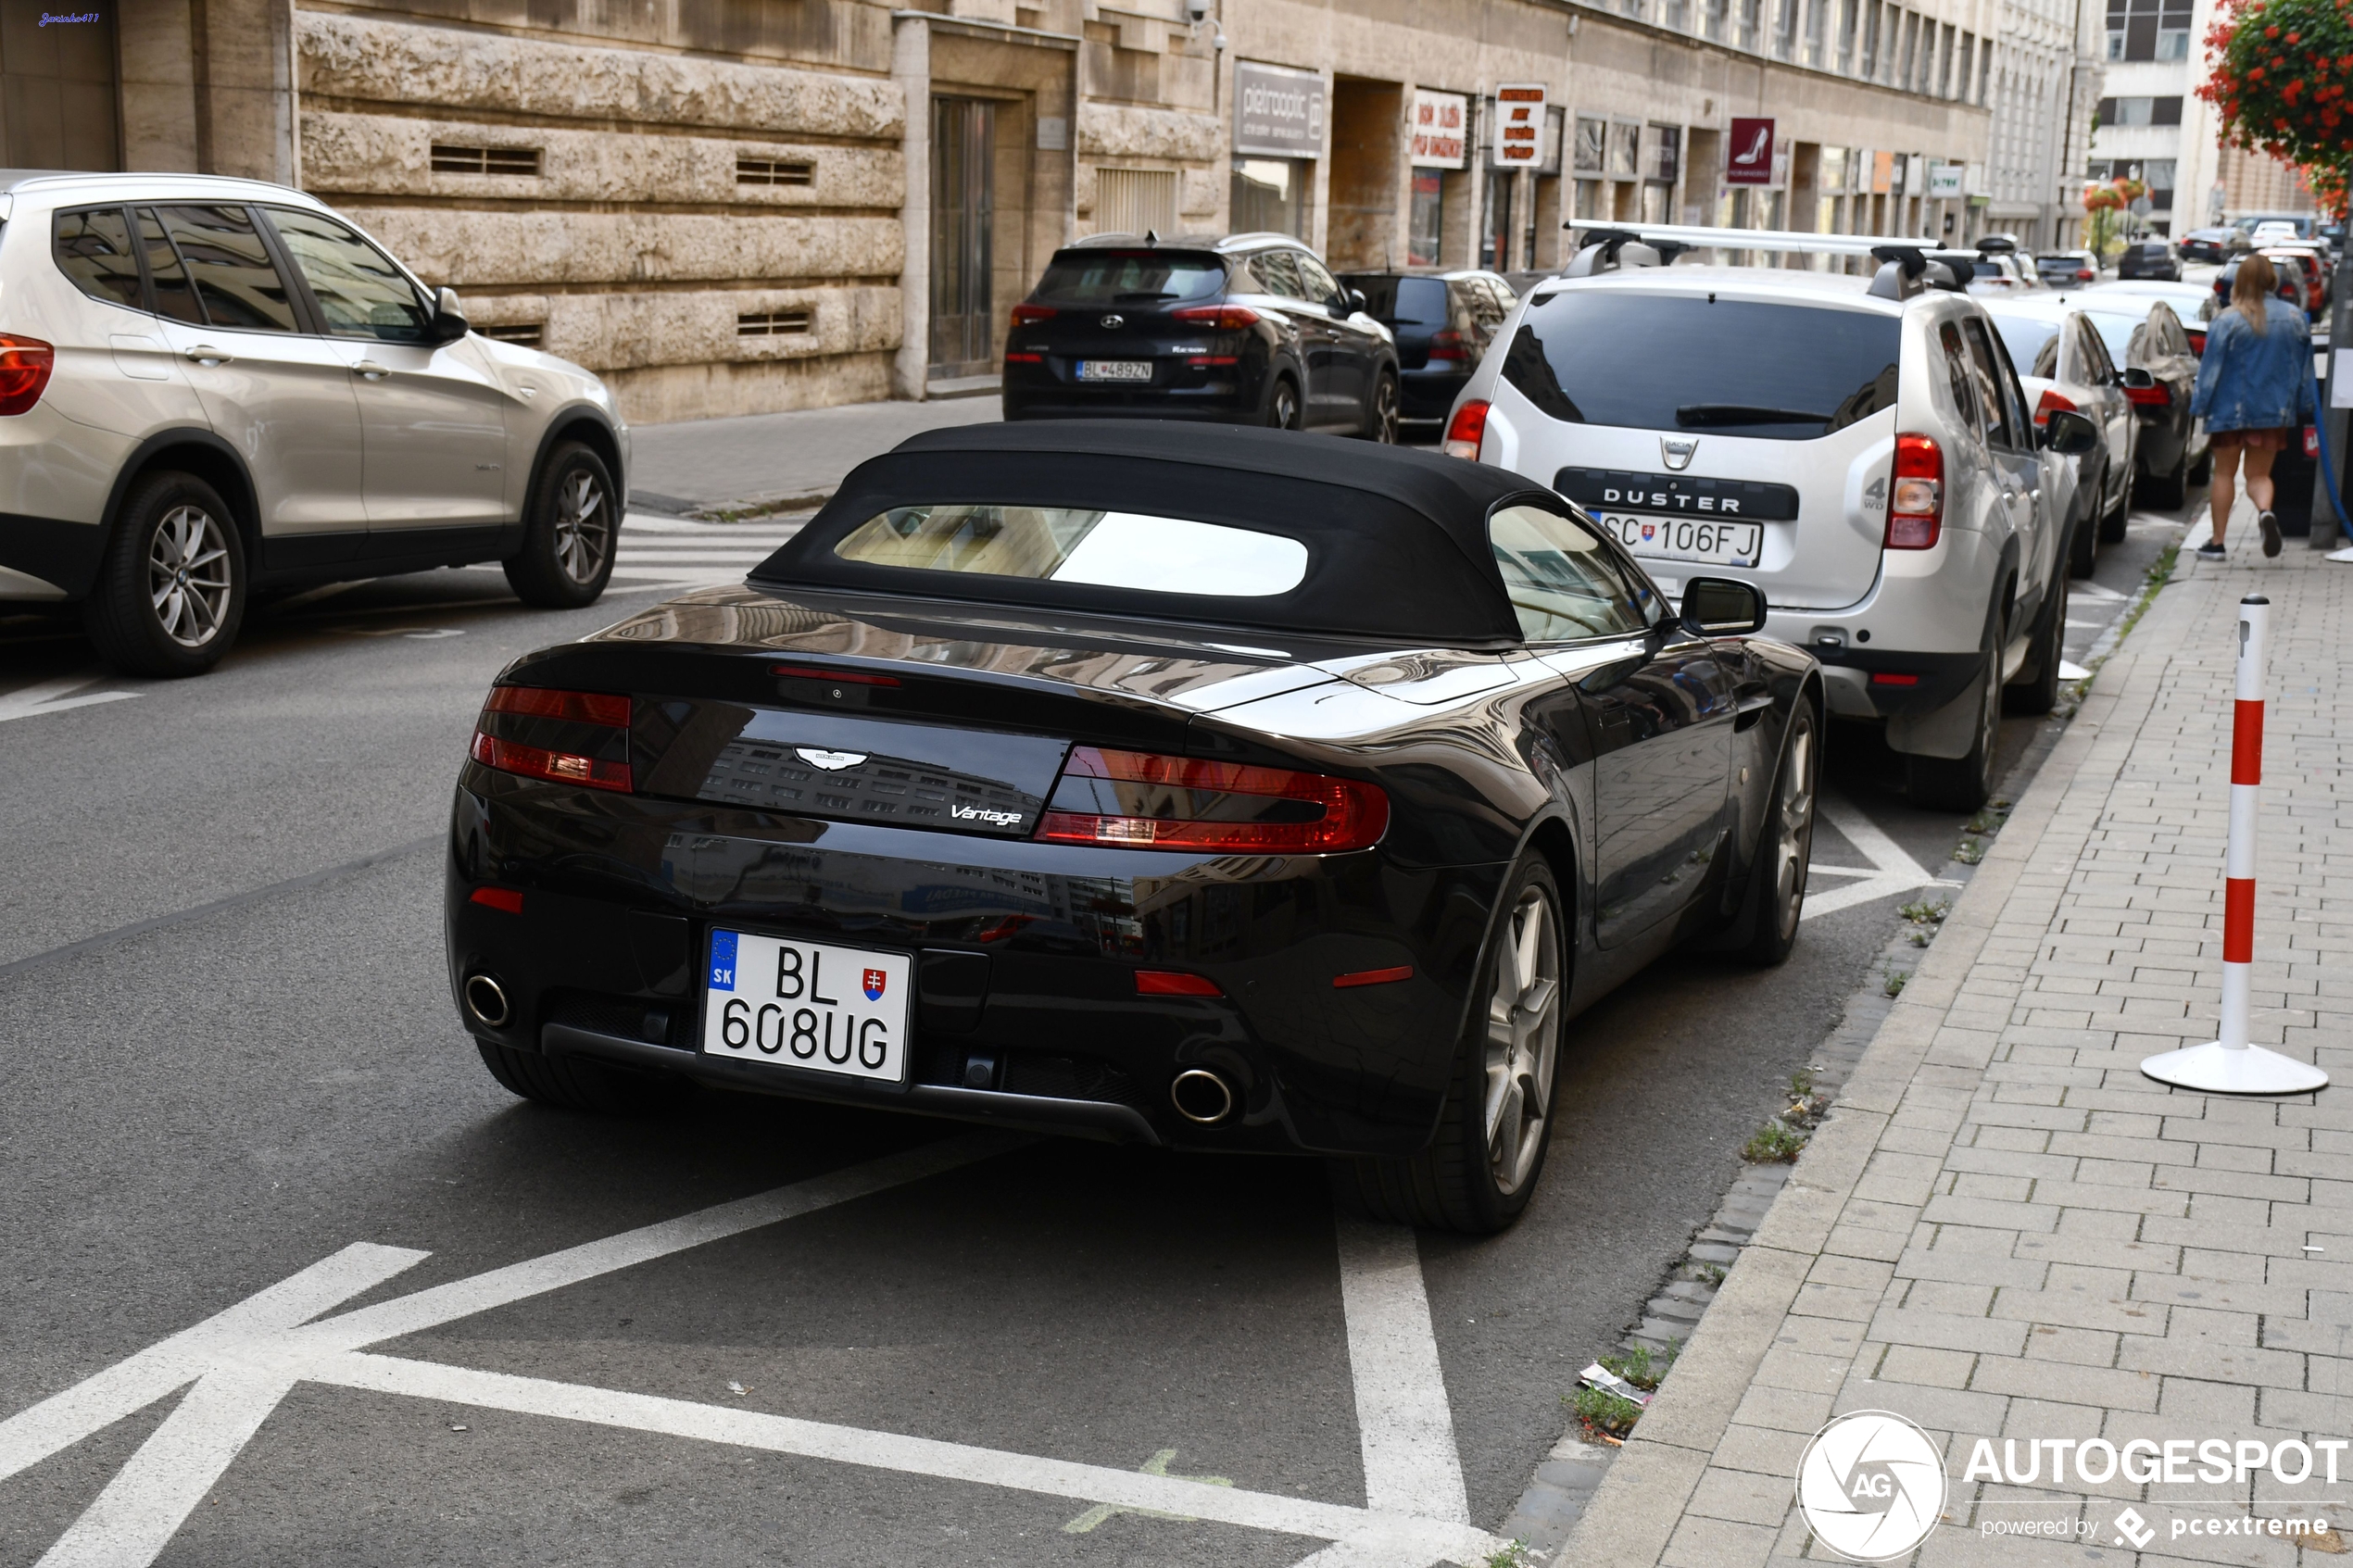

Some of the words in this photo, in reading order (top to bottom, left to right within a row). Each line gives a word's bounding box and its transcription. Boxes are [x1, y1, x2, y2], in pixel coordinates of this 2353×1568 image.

[1084, 362, 1100, 377] BL
[1604, 489, 1740, 513] DUSTER
[1661, 521, 1755, 556] 106FJ
[951, 804, 1022, 825] Vantage
[713, 968, 732, 985] SK
[776, 946, 838, 1006] BL
[723, 998, 887, 1070] 608UG
